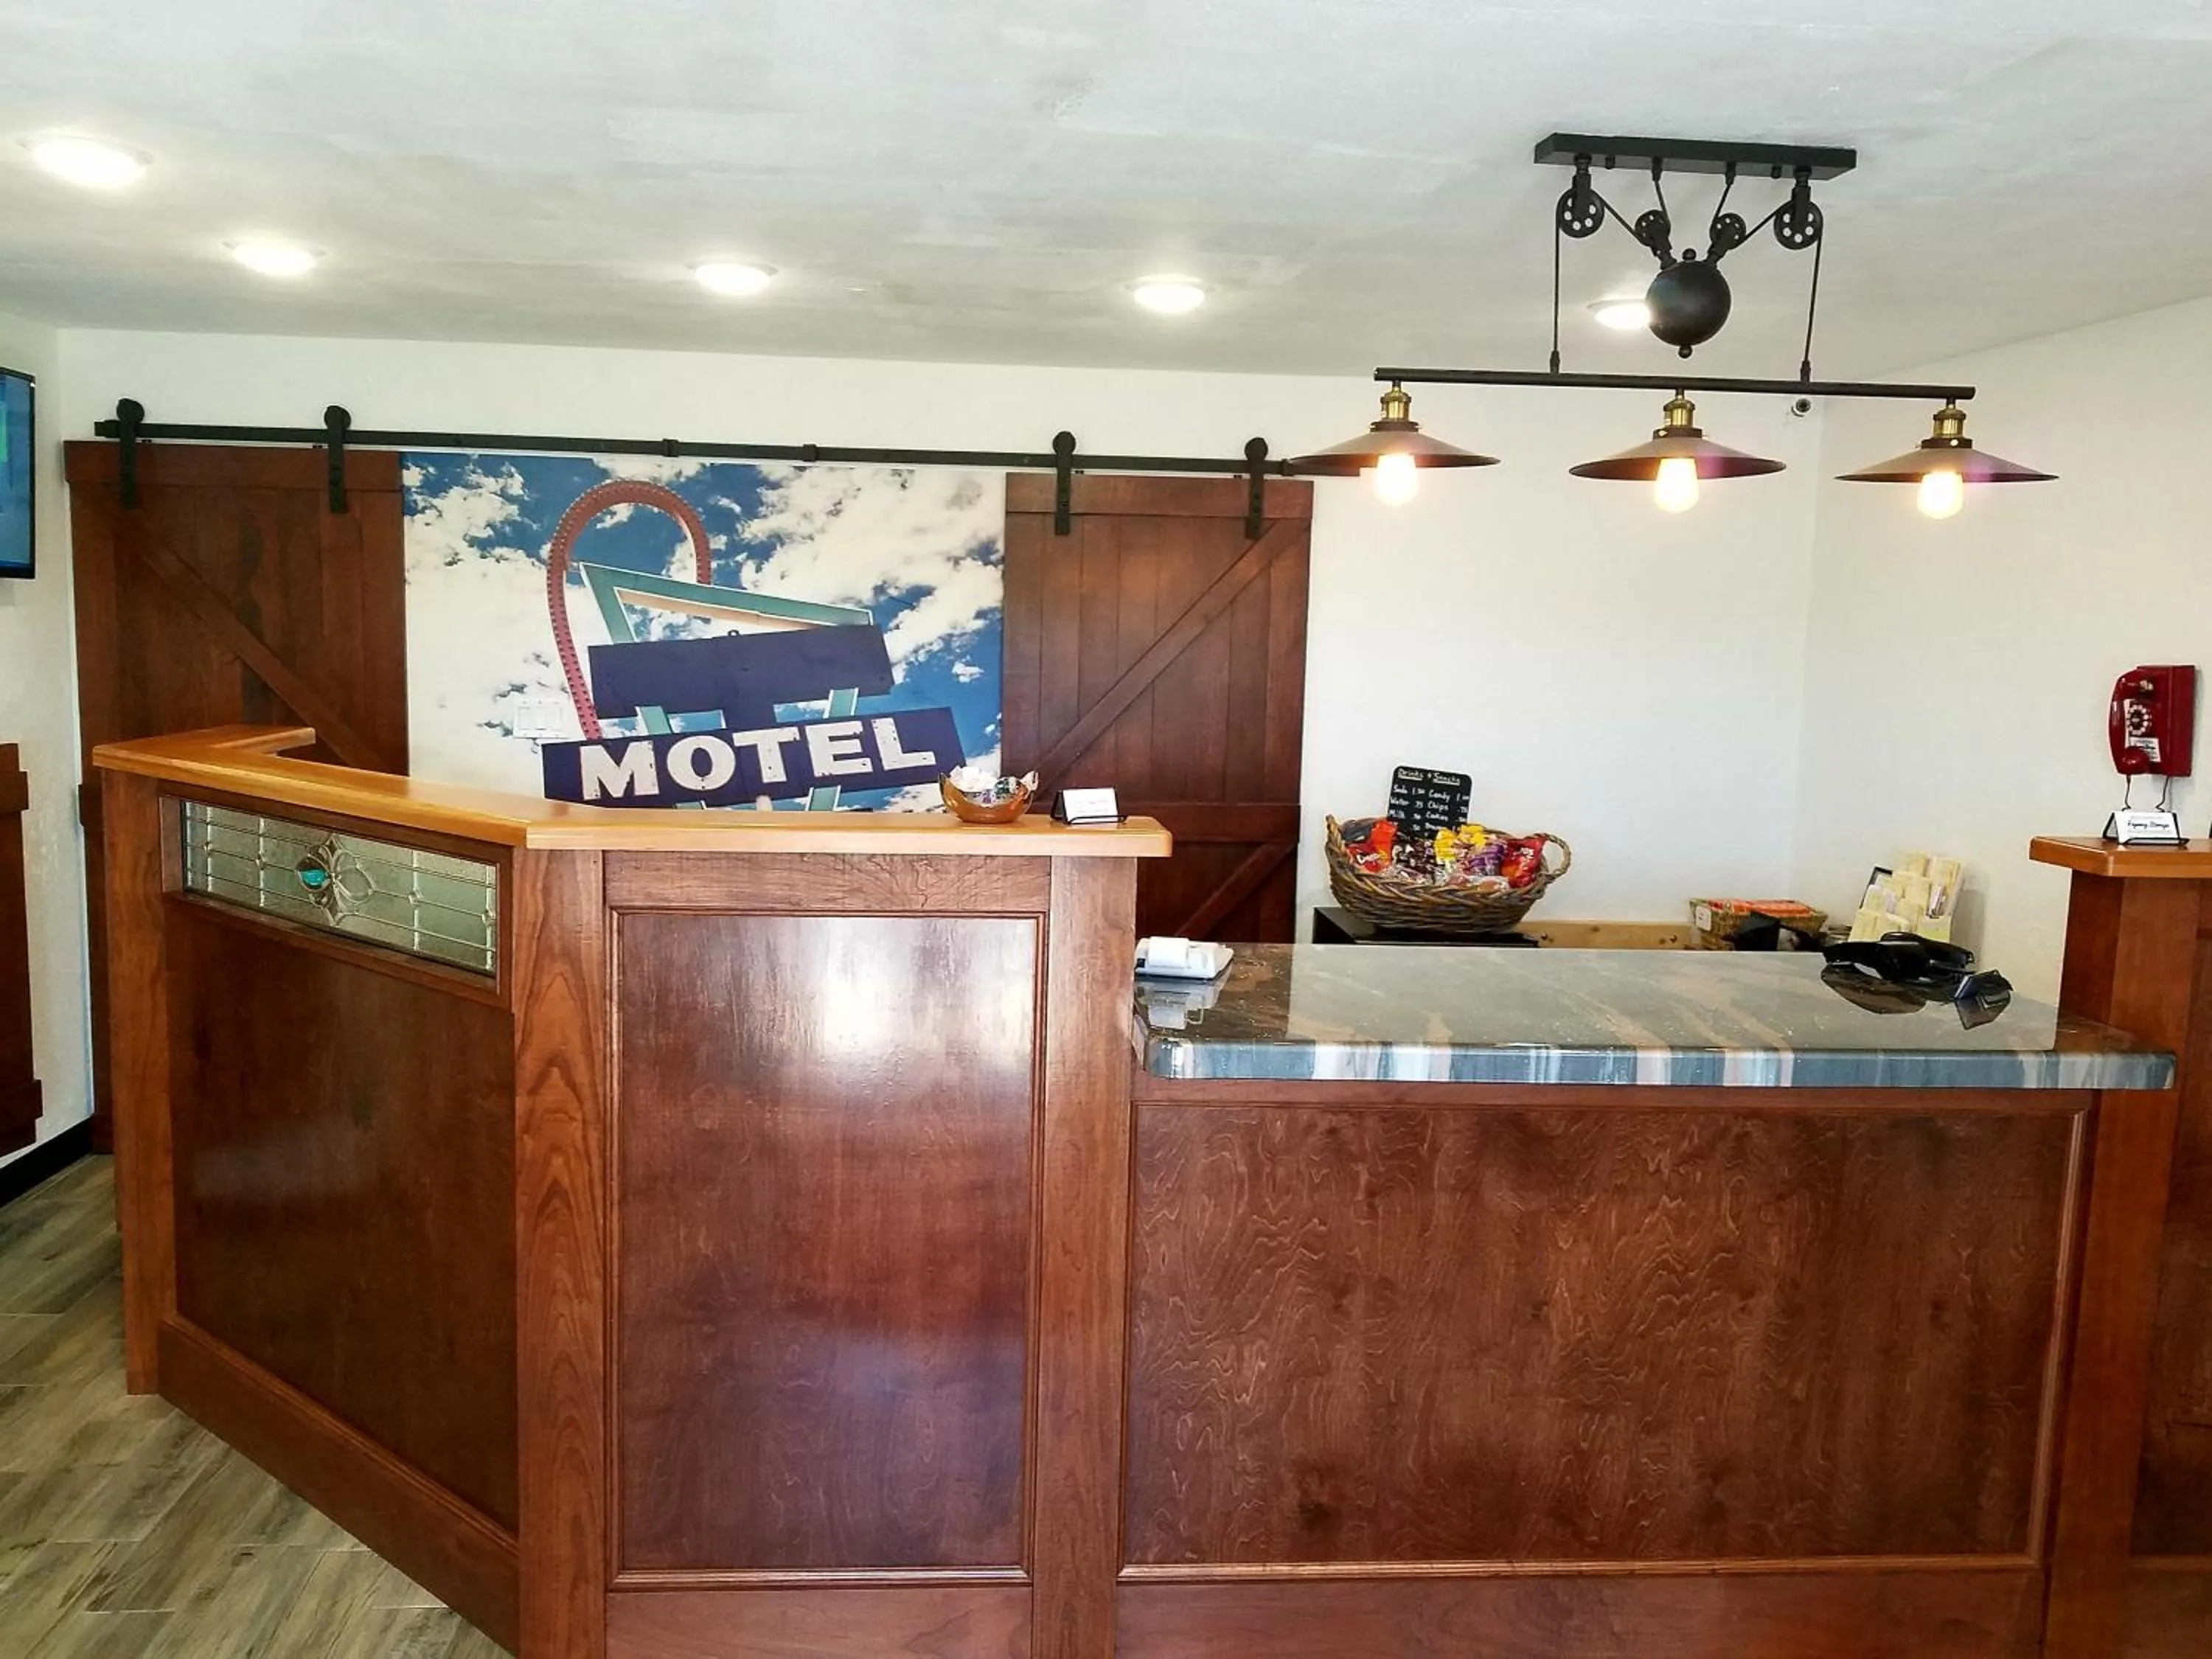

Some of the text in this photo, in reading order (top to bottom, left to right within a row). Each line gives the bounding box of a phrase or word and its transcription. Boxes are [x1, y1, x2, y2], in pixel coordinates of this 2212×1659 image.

[580, 717, 936, 801] MOTEL
[1428, 789, 1450, 803] Candy
[1427, 800, 1449, 813] Chips
